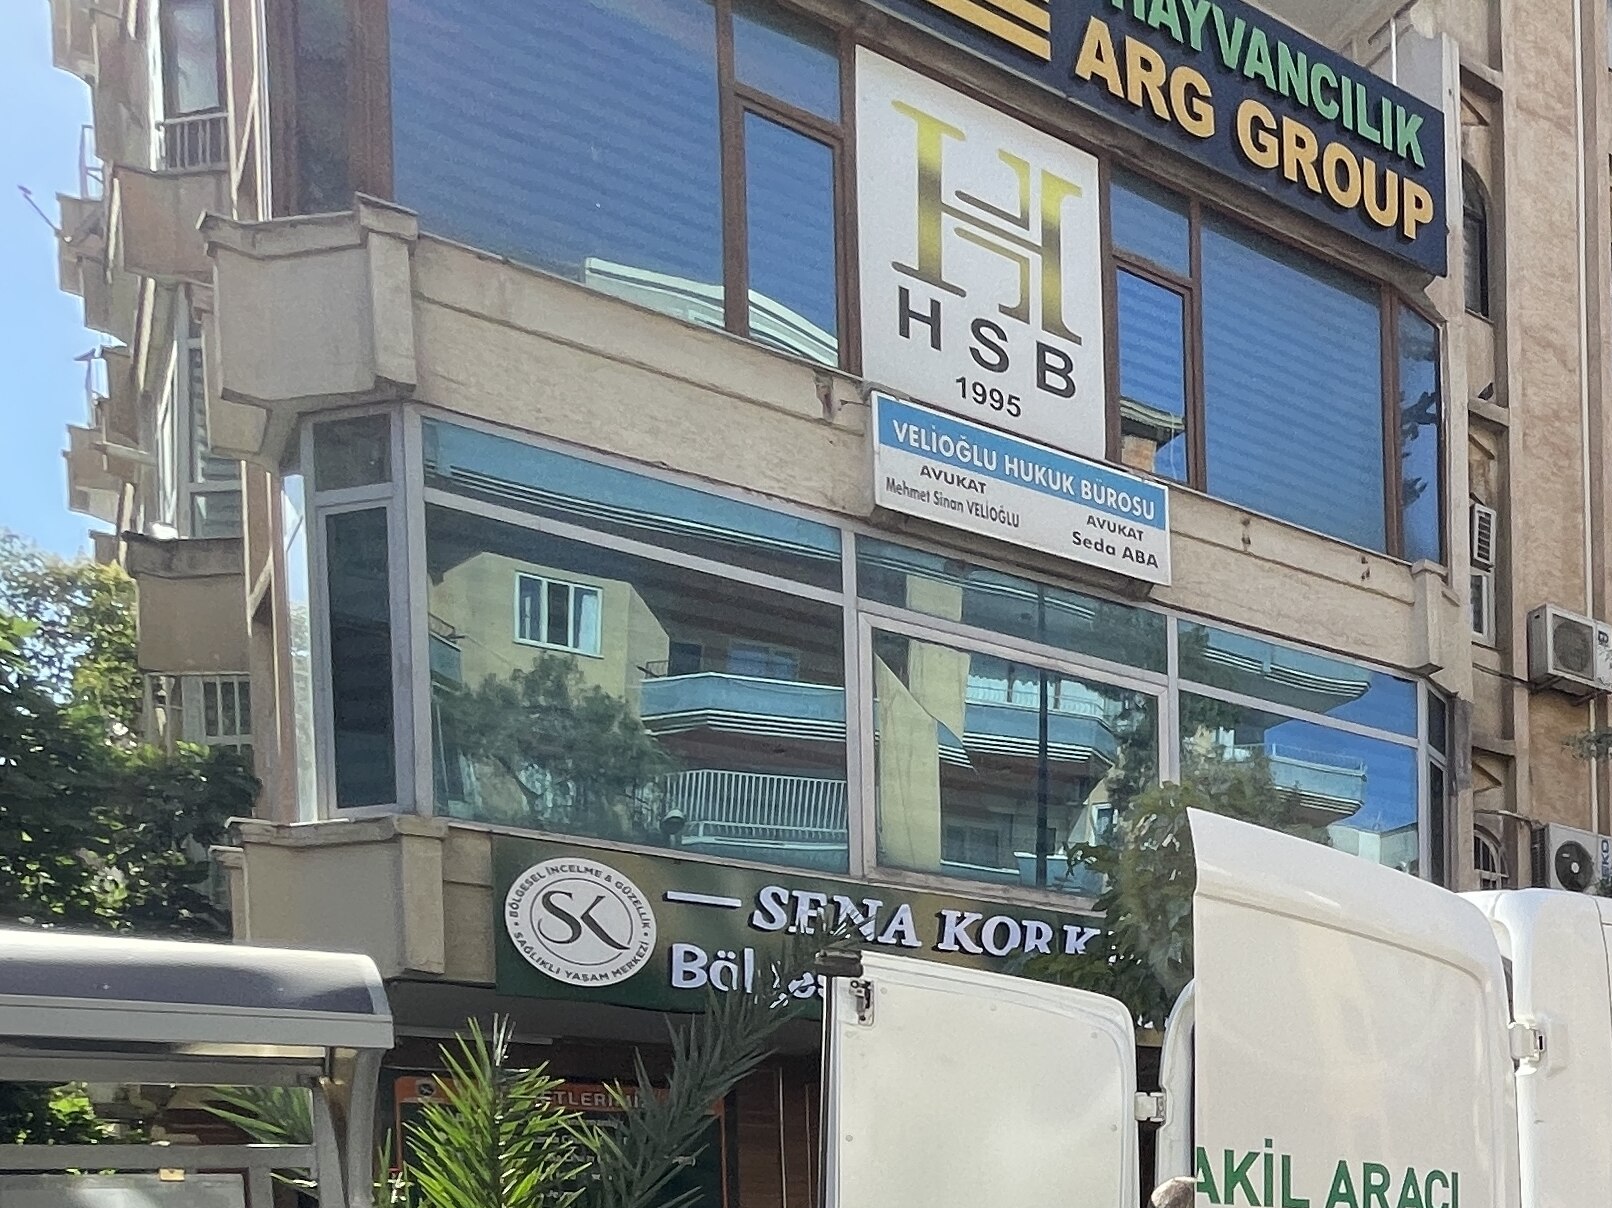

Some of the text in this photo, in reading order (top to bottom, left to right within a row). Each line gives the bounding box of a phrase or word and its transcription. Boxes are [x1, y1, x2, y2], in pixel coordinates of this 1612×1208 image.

[1075, 15, 1434, 240] ARG GROUP
[955, 376, 1022, 418] 1995
[893, 419, 1155, 520] VELİOĞLU HUKUK BÜROSU
[920, 465, 987, 495] AVUKAT
[886, 477, 930, 504] Mehmet
[933, 490, 963, 513] Sinan
[1086, 514, 1144, 541] AVUKAT
[1072, 531, 1159, 568] Seda ABA
[546, 865, 603, 878] İNCELME
